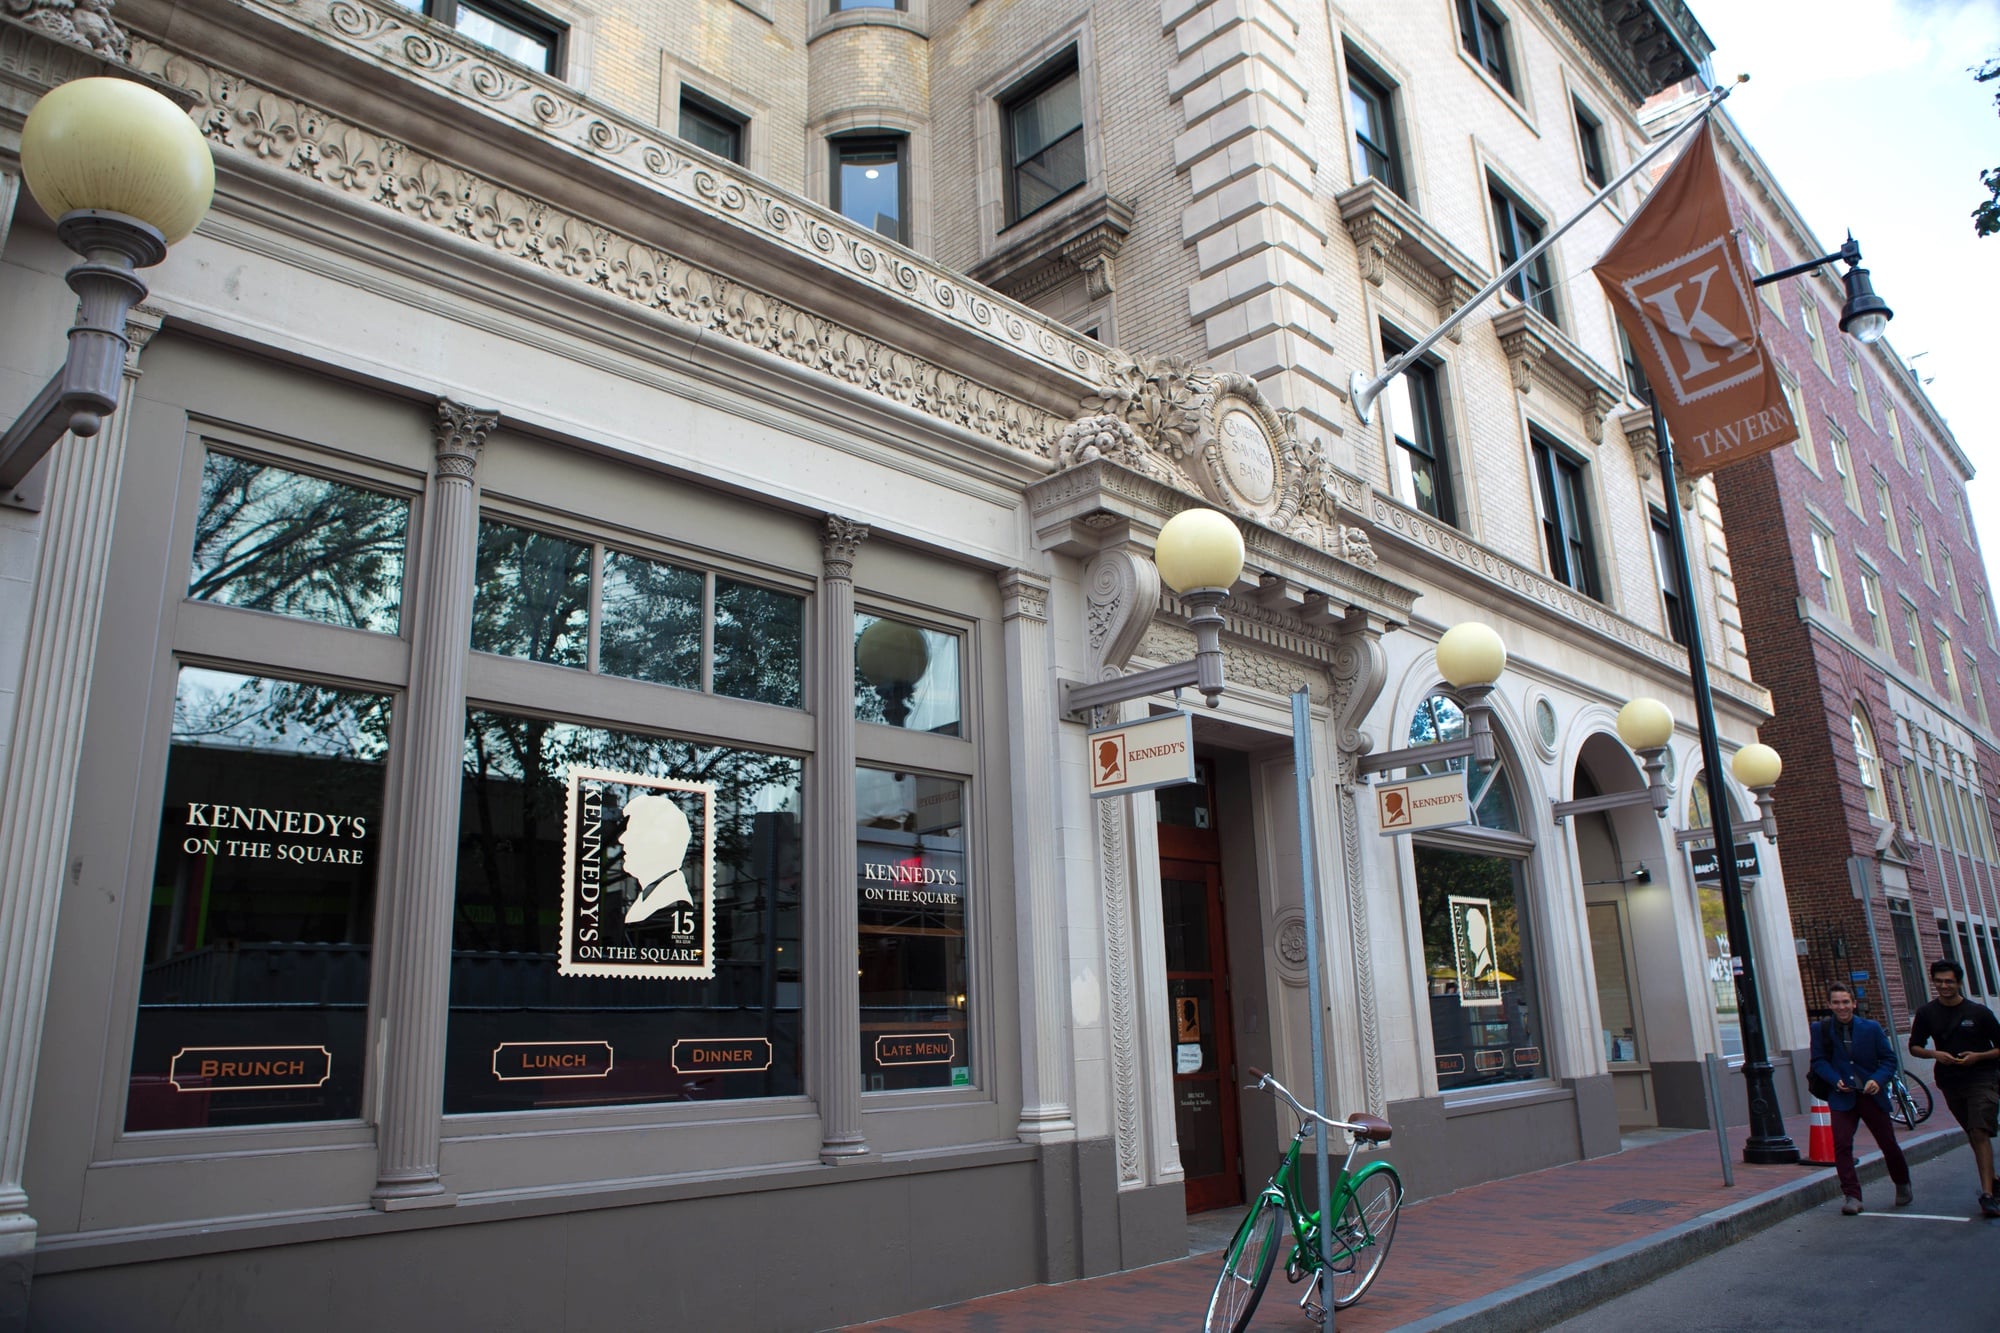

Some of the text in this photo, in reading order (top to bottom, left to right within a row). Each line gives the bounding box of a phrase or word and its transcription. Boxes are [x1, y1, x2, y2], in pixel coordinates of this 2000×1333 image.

[1643, 265, 1753, 380] K
[1692, 402, 1789, 457] TAVERN
[1232, 440, 1270, 469] SAVINGS
[1240, 462, 1266, 486] BANK
[1129, 741, 1185, 762] KENNEDY'S
[1412, 793, 1464, 809] KENNEDY'S
[186, 802, 366, 839] KENNEDY'S
[183, 838, 364, 865] ON THE SQUARE
[579, 786, 602, 942] KENNEDY'S
[864, 863, 957, 886] KENNEDY'S
[865, 888, 957, 905] ON THE SQUARE
[671, 911, 695, 935] 15
[579, 946, 699, 963] ON THE SQUARE
[1454, 905, 1469, 989] KENNEDY'S
[522, 1049, 753, 1068] LUNCH DINNER
[883, 1043, 948, 1056] LATE MENU
[201, 1060, 304, 1077] BRUNCH
